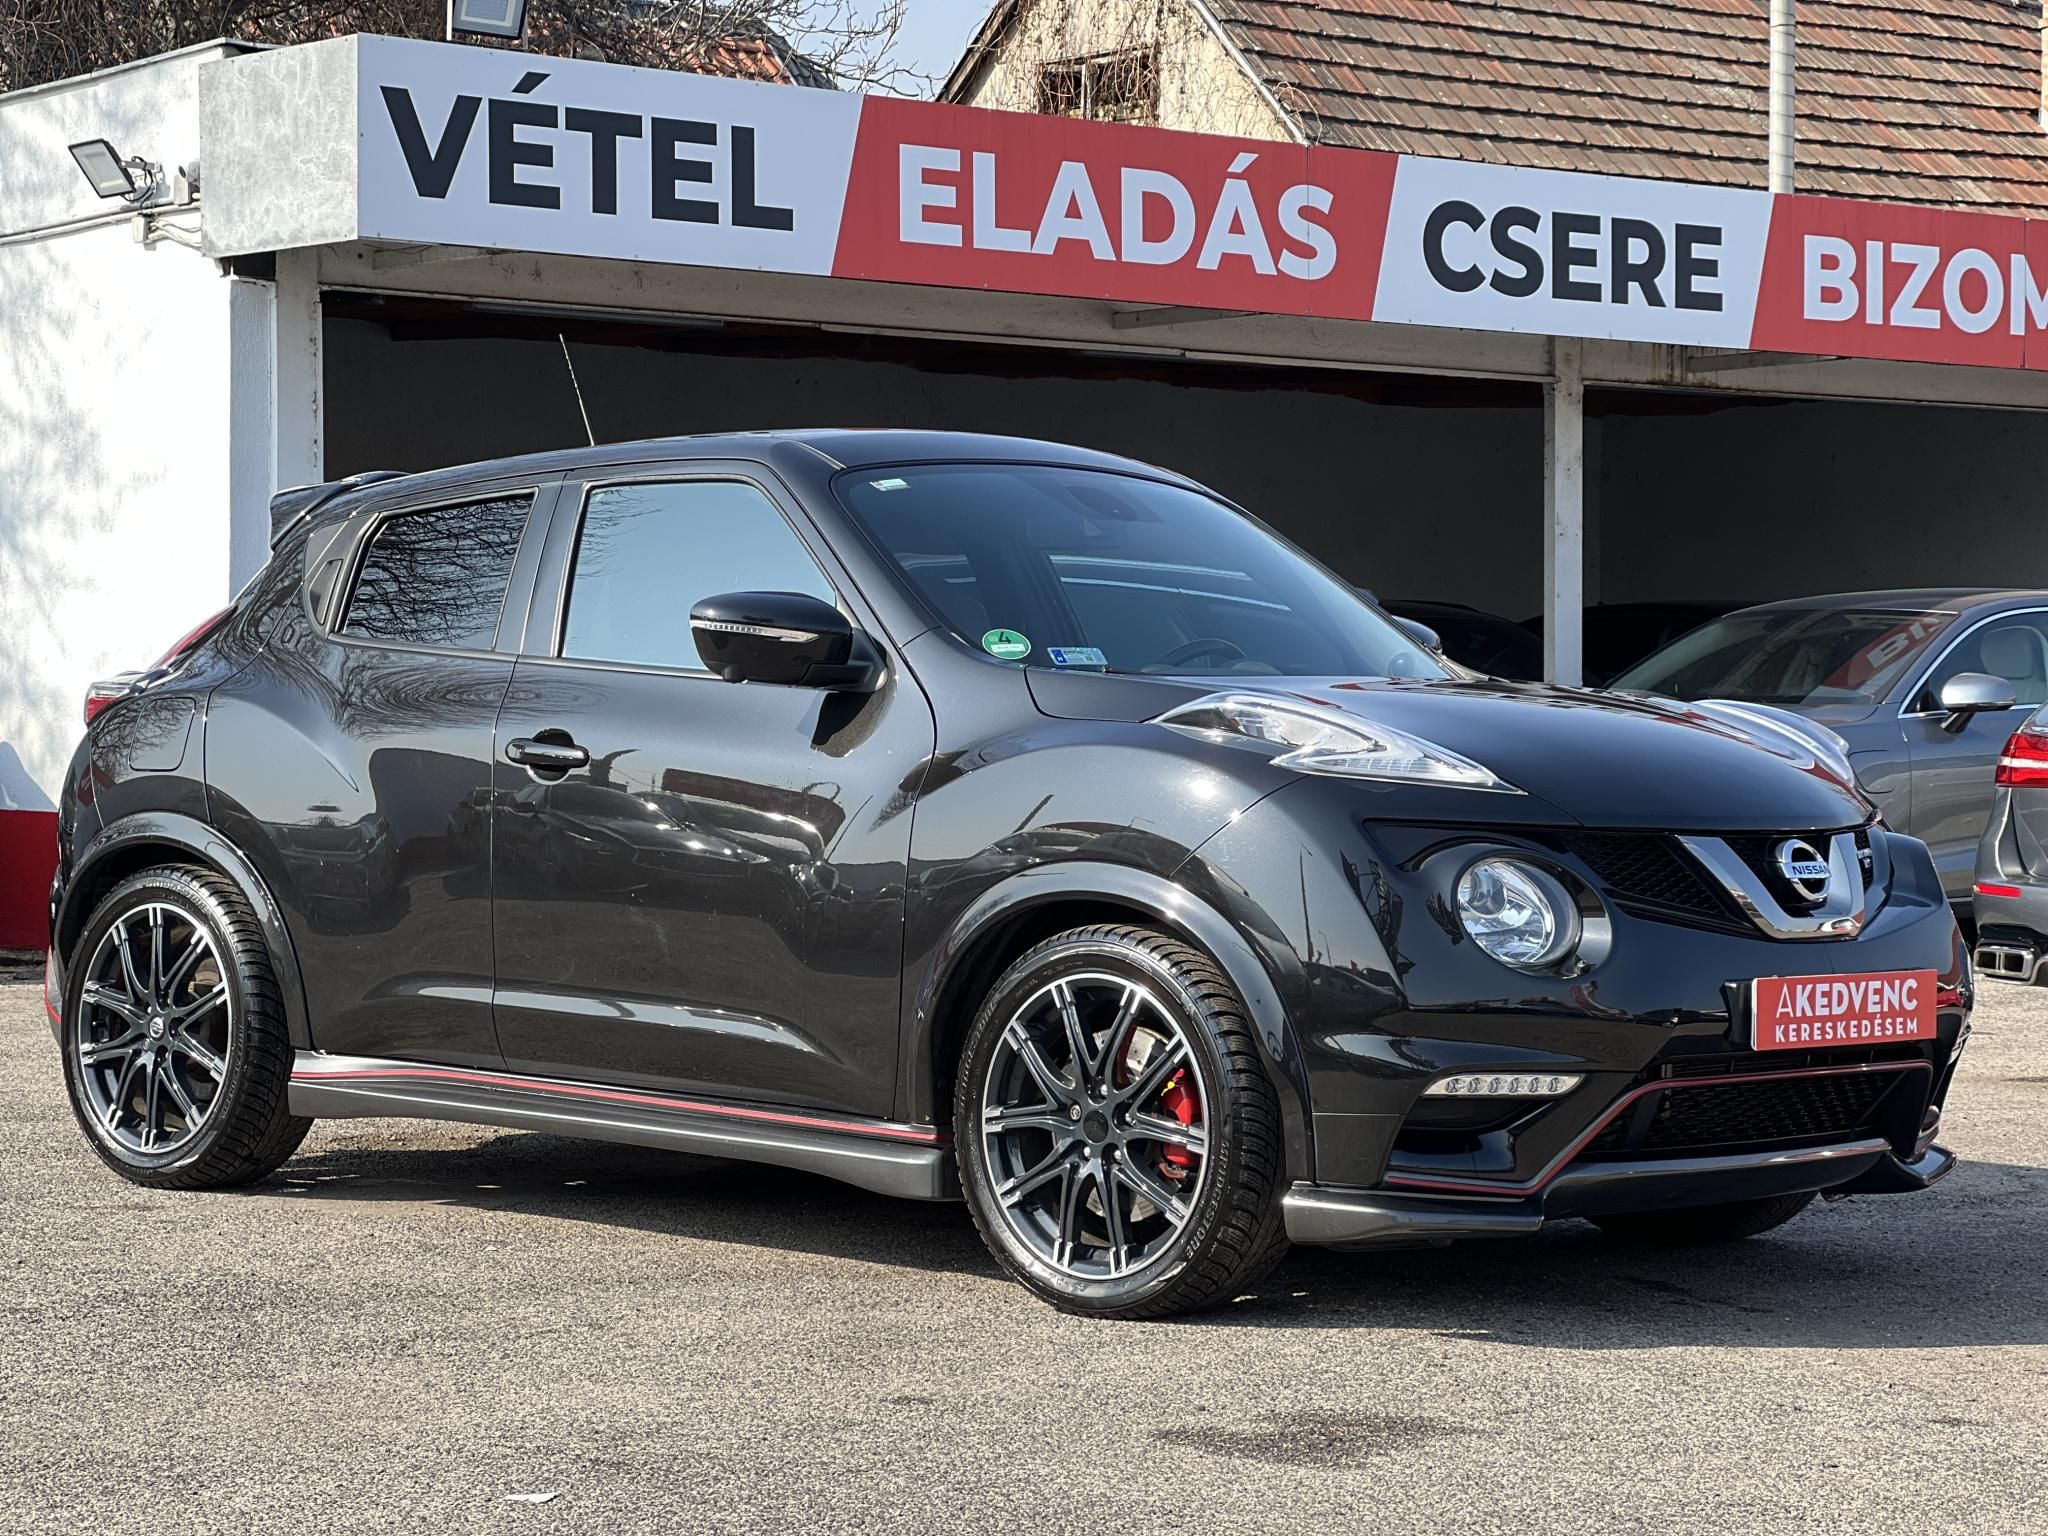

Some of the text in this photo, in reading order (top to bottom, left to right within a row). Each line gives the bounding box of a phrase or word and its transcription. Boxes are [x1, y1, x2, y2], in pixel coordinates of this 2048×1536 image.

[380, 72, 794, 232] VÉTEL
[899, 144, 1338, 281] ELADÁS
[1422, 200, 1723, 312] CSERE
[1791, 865, 1831, 876] NISSAN
[1775, 1013, 1918, 1043] KERESKEDÉSEM
